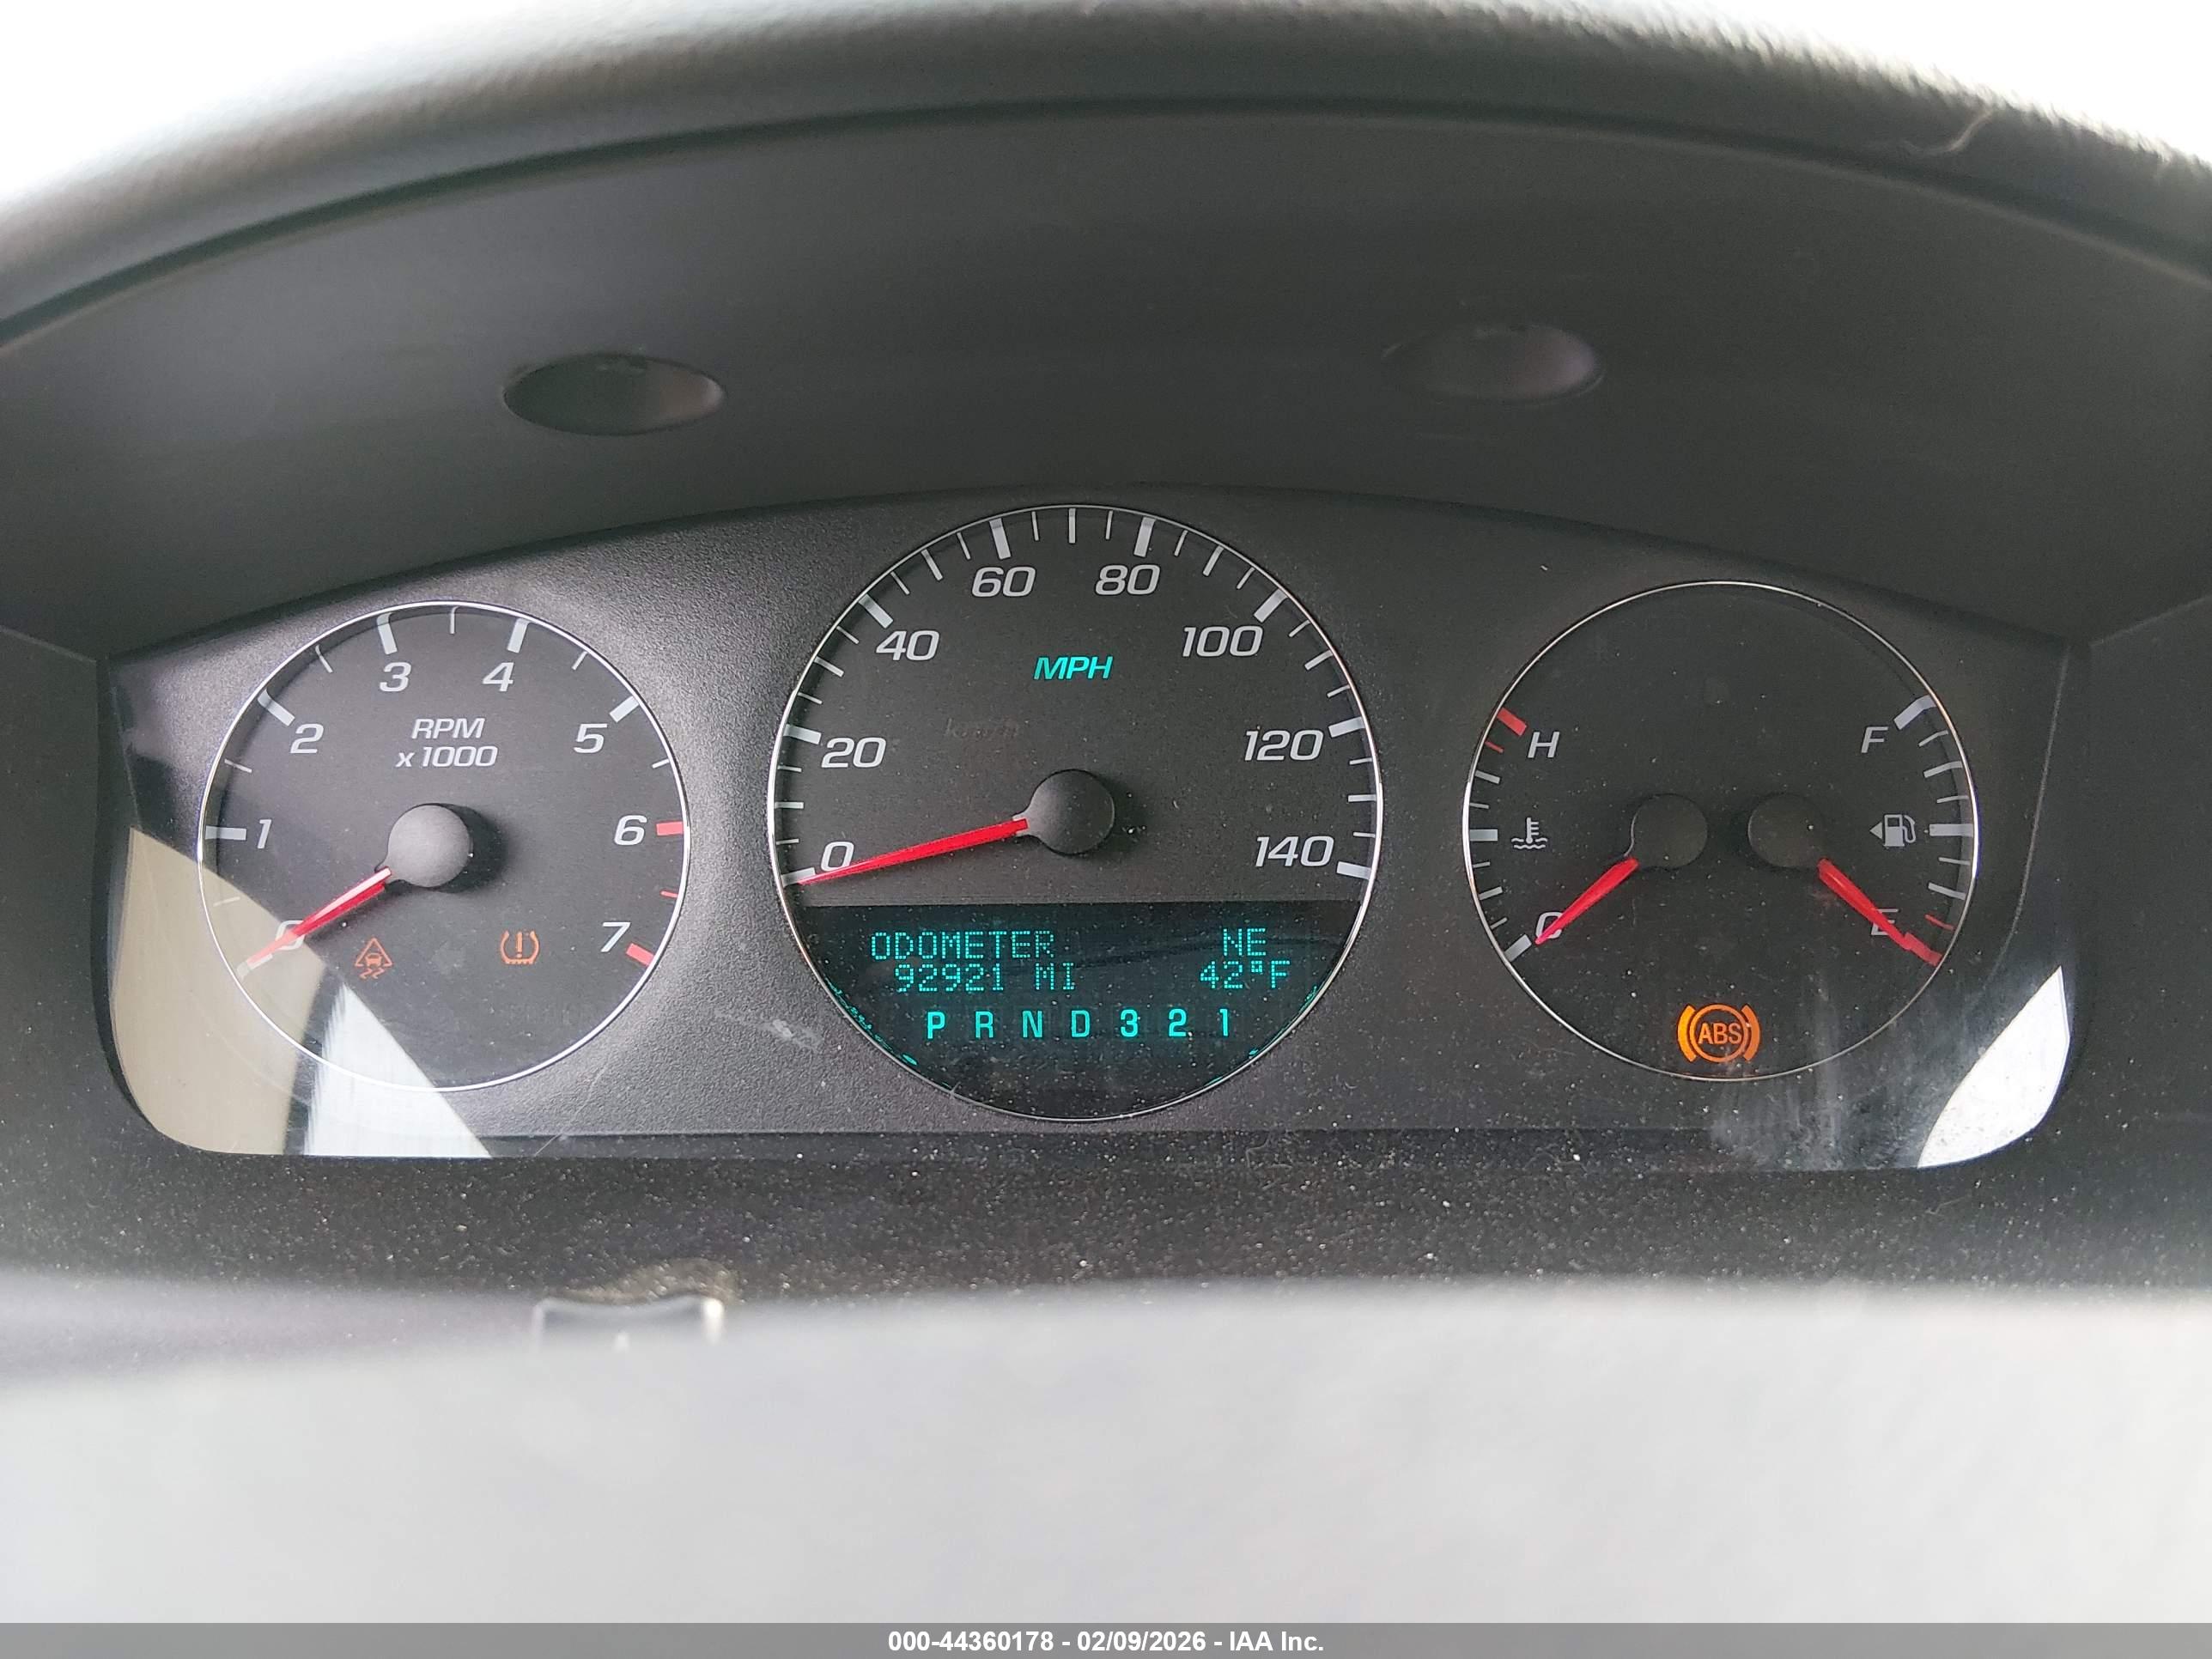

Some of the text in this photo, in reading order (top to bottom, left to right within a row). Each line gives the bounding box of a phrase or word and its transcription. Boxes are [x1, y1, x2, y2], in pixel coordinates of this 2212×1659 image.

[971, 567, 1036, 598] 60
[1094, 565, 1160, 595] 80
[875, 629, 939, 660] 40
[1182, 626, 1263, 657] 100
[379, 662, 410, 691] 3
[483, 662, 515, 691] 4
[1033, 656, 1113, 680] MPH
[290, 724, 325, 754] 2
[411, 718, 484, 738] RPM
[574, 724, 608, 753] 5
[1861, 726, 1888, 754] F
[821, 738, 886, 768] 20
[1244, 730, 1324, 761] 120
[1528, 732, 1560, 758] H
[258, 819, 272, 849] 1
[614, 815, 647, 846] 6
[820, 841, 854, 872] 0
[1255, 836, 1334, 866] 140
[601, 921, 631, 952] 7
[871, 931, 1054, 960] ODOMETER
[1223, 927, 1267, 957] NE
[895, 962, 1075, 992] 92921 MI
[1200, 960, 1290, 989] 42°F
[927, 1008, 1229, 1039] P R N D 3 2 1
[1698, 1023, 1740, 1044] ABS
